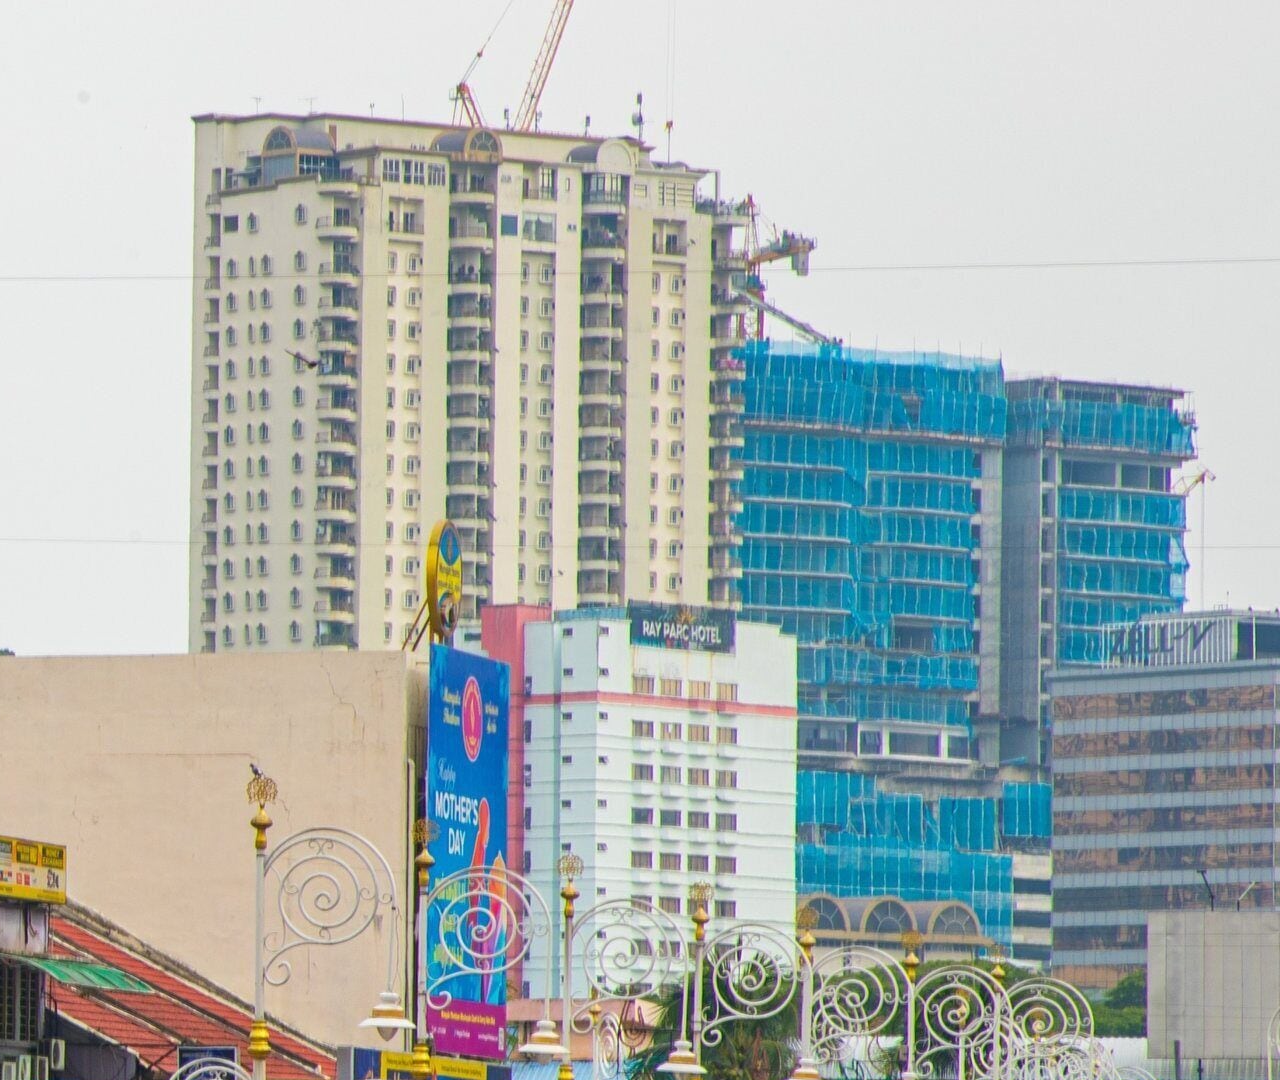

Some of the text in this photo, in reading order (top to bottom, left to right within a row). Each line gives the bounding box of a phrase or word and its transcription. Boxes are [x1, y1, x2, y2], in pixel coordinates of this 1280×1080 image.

[643, 620, 721, 644] RAY PARC HOTEL
[435, 791, 479, 826] MOTHER'S
[448, 827, 465, 856] DAY
